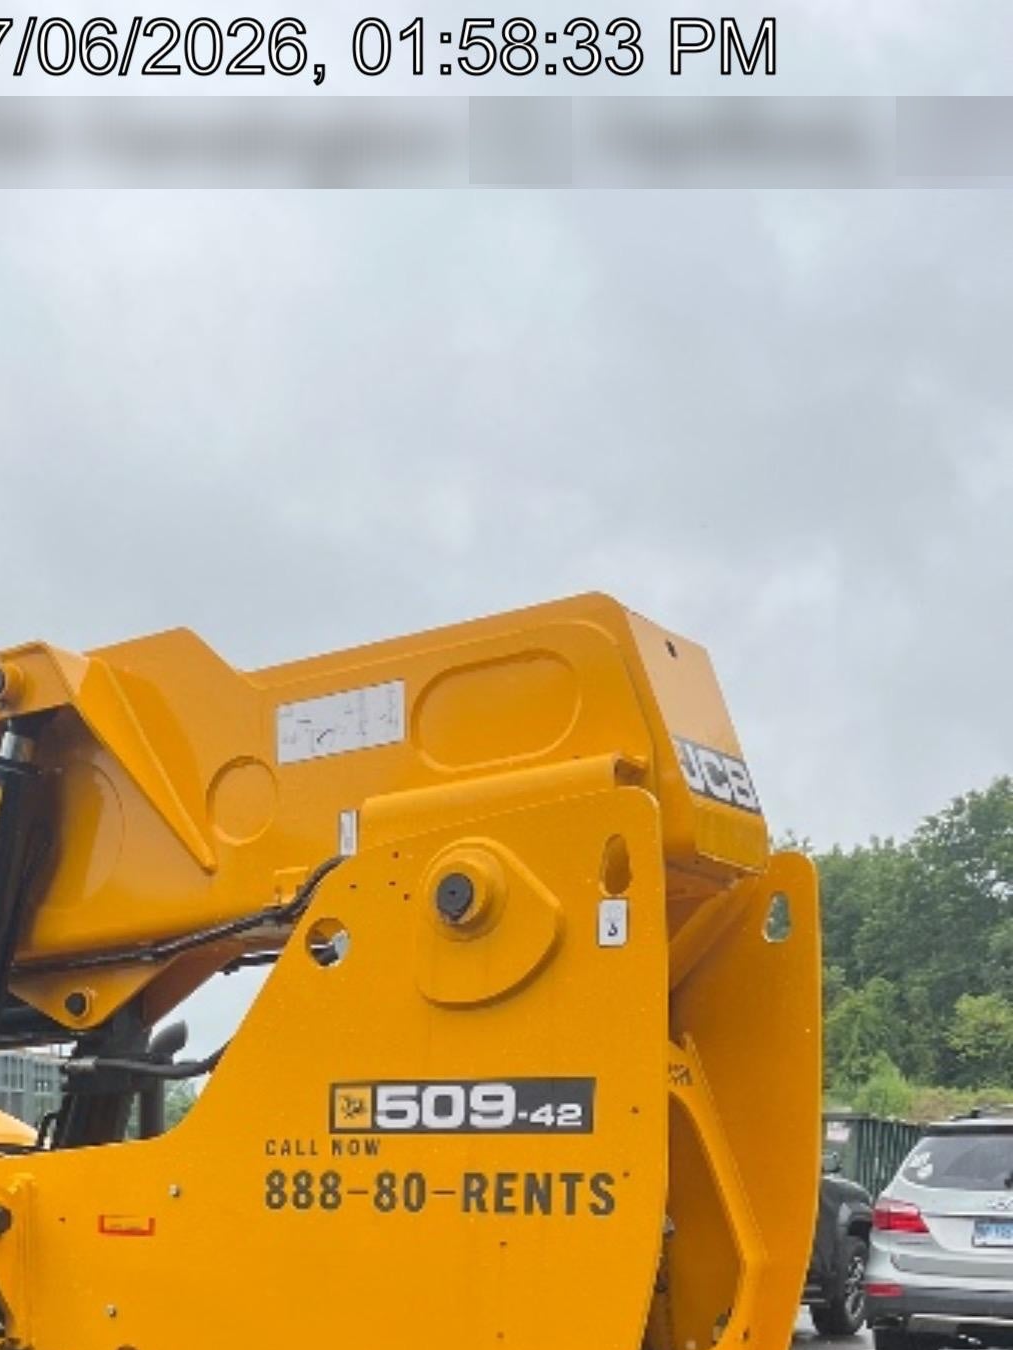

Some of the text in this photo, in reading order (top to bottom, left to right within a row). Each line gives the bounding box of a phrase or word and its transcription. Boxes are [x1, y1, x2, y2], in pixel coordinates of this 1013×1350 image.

[679, 743, 759, 809] JCB
[375, 1083, 582, 1130] 509-42
[265, 1139, 381, 1156] CALL NOW
[265, 1169, 616, 1216] 888-80-RENTS
